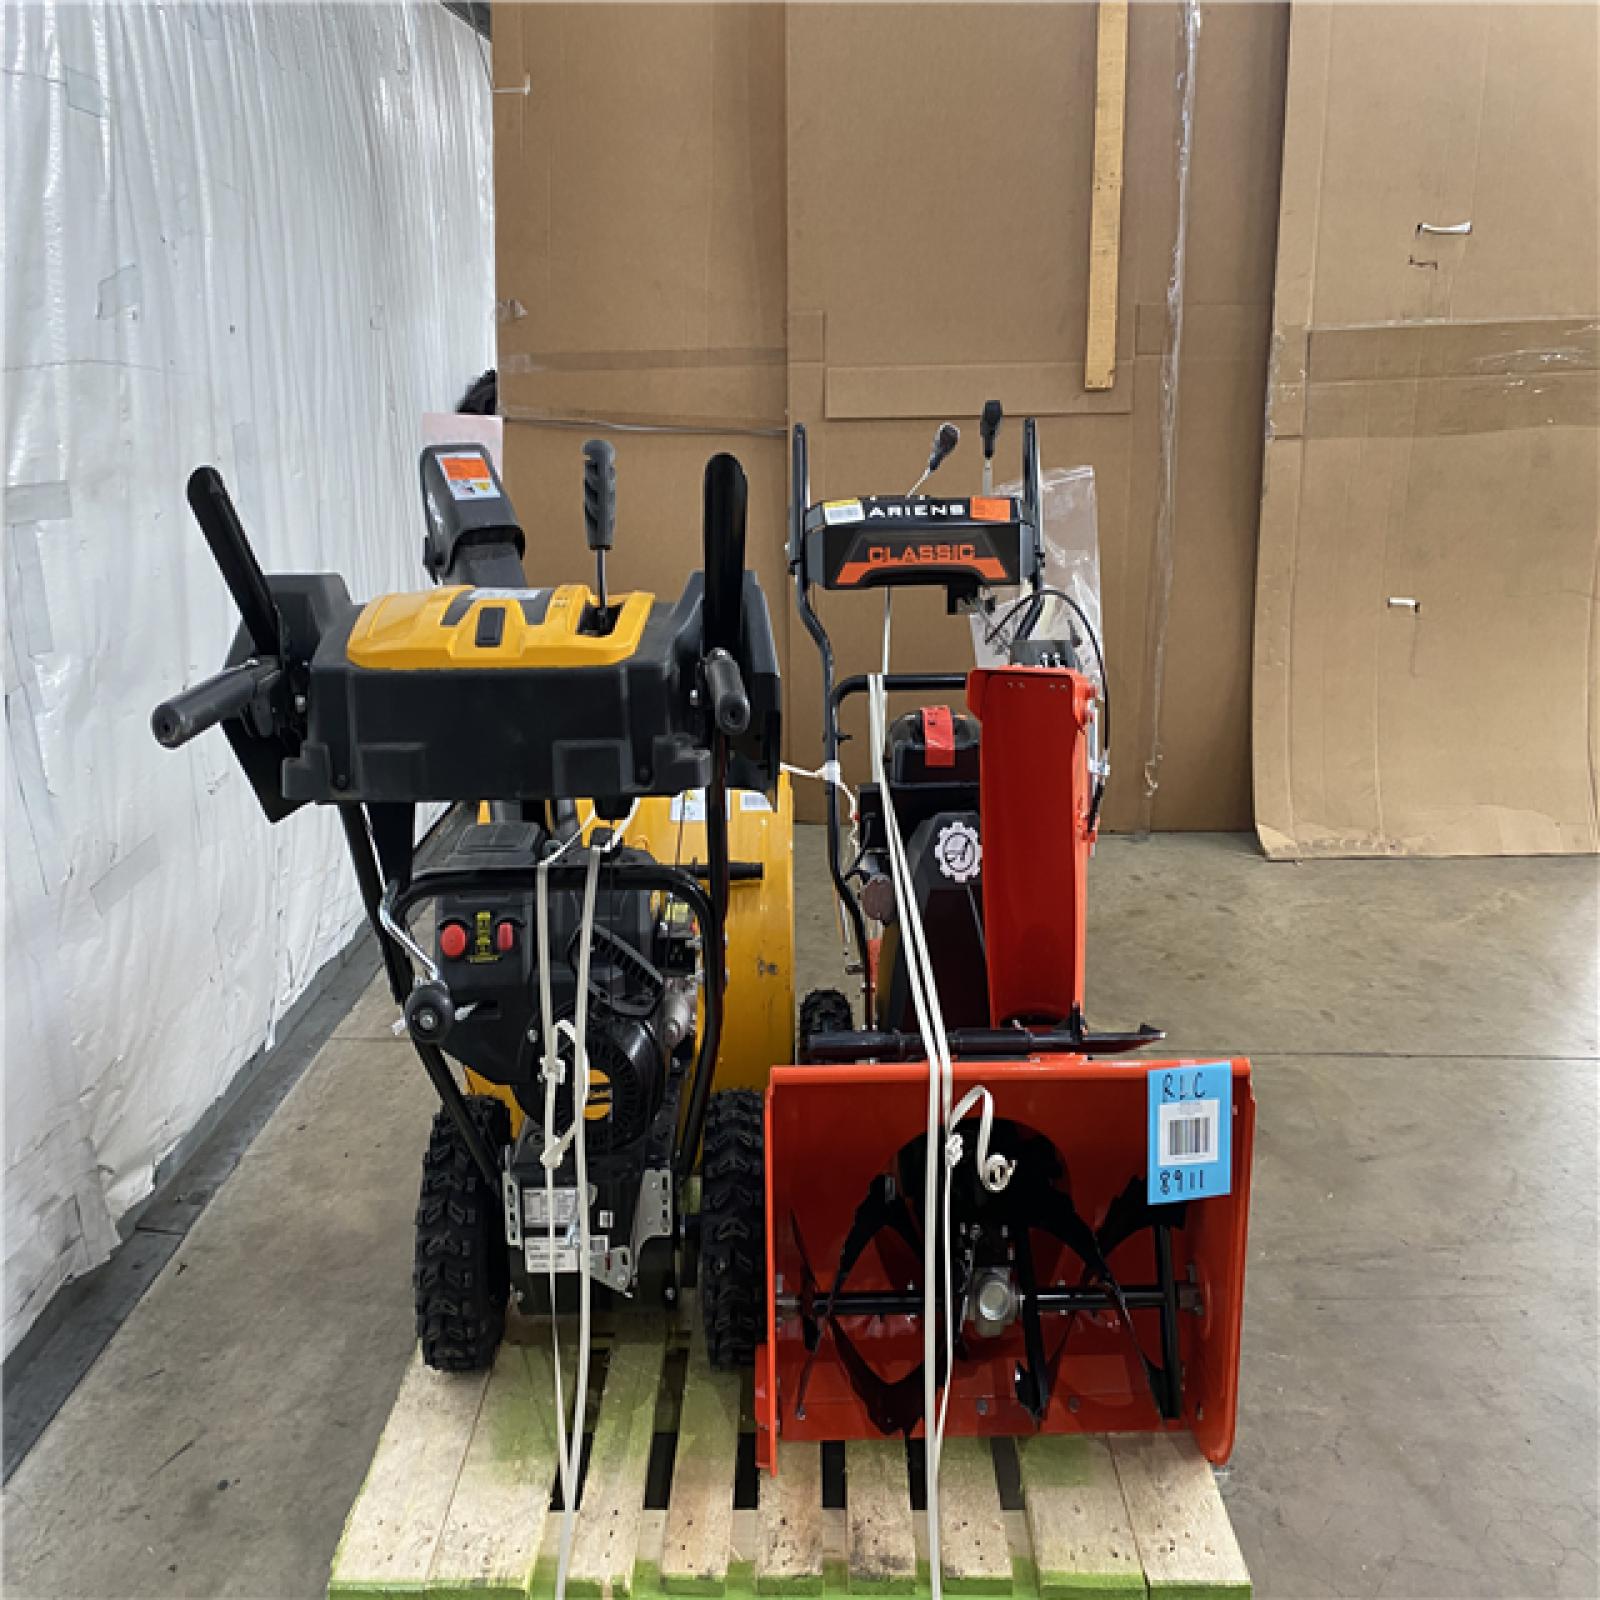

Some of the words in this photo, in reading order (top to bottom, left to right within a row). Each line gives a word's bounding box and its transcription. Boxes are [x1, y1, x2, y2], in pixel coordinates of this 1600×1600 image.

[870, 504, 966, 518] ARIENS
[868, 544, 976, 563] CLASSIC
[1159, 1169, 1205, 1195] 8911
